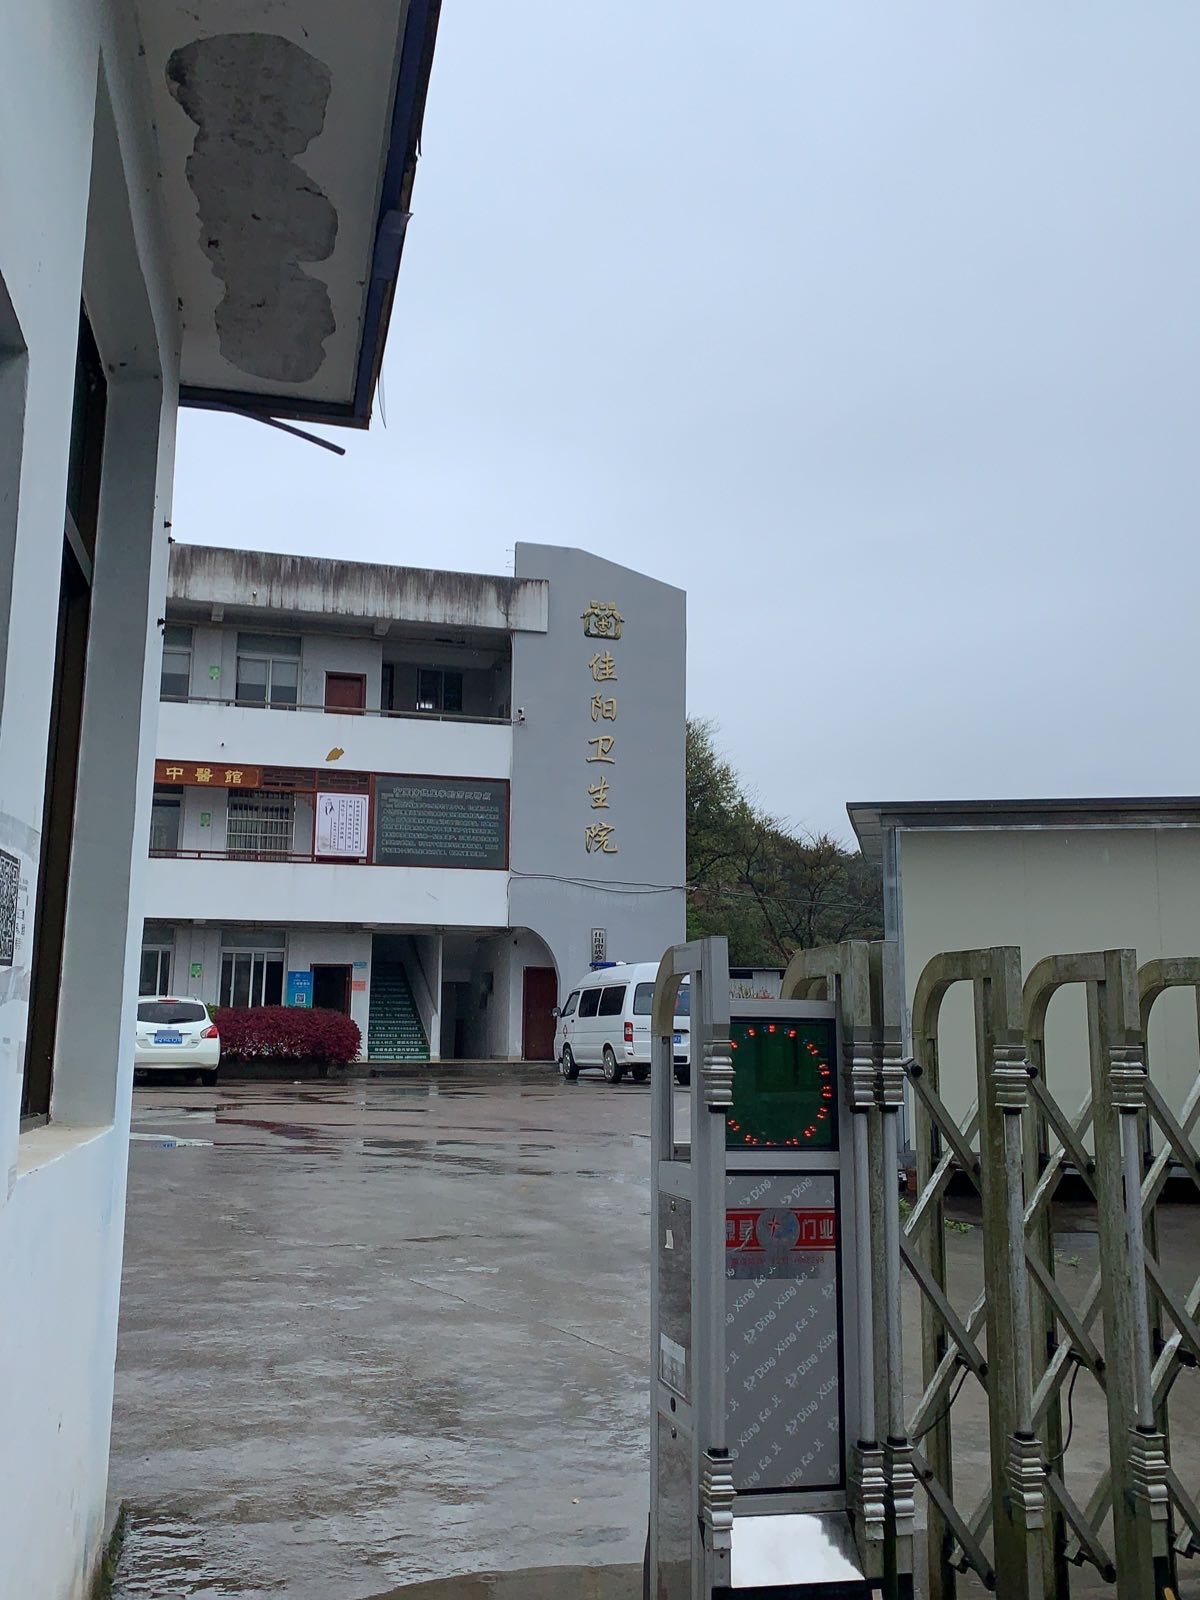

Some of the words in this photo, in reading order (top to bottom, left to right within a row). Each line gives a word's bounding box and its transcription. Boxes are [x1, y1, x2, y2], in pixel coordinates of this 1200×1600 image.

[585, 651, 618, 854] 佳阳卫生院
[166, 766, 243, 784] 中醫館
[802, 1219, 834, 1240] 门业
[732, 1288, 756, 1312] Xing
[755, 1310, 777, 1332] Ding
[774, 1286, 797, 1310] Xing
[754, 1356, 777, 1379] Ding
[774, 1332, 797, 1356] Xing
[795, 1318, 808, 1332] Ke
[797, 1353, 818, 1376] Ding
[797, 1400, 819, 1423] Ding
[737, 1422, 761, 1447] Xing
